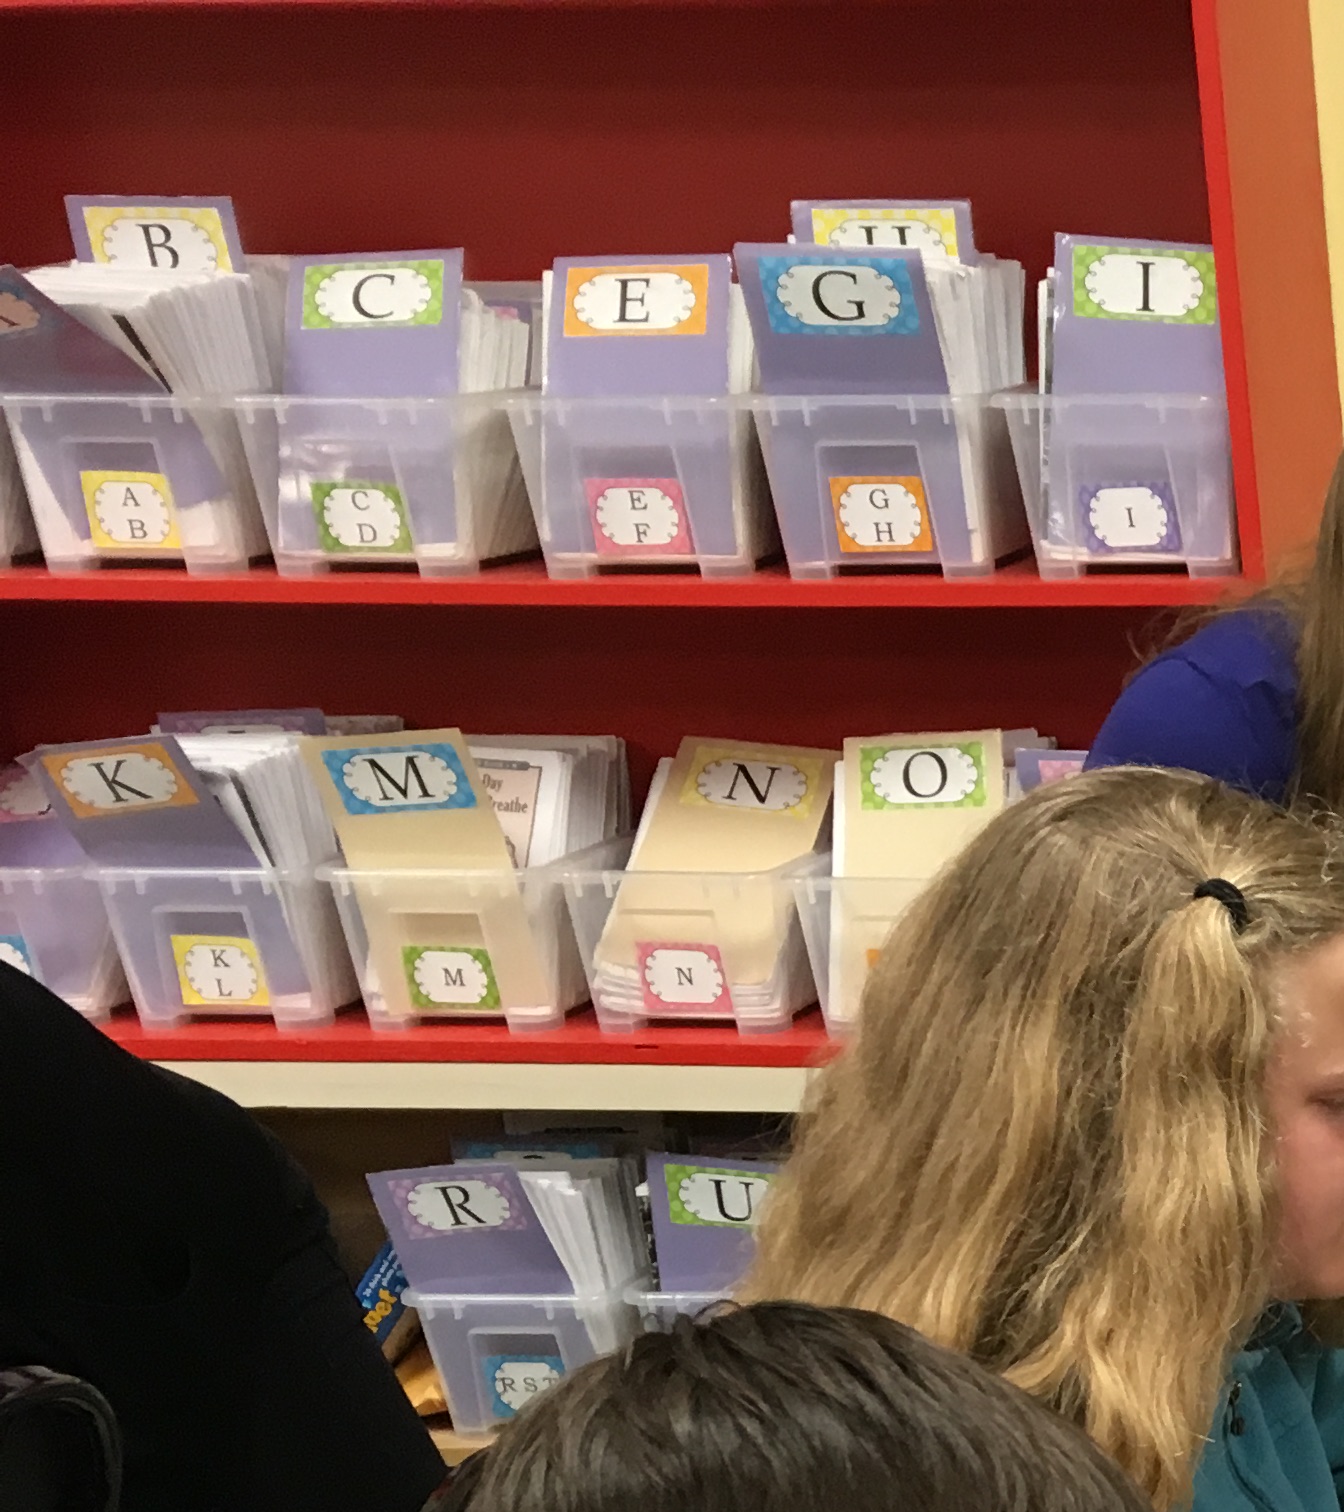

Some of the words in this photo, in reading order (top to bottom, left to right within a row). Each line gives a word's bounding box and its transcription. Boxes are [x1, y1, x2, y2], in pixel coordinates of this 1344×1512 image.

[136, 222, 180, 269] B
[352, 273, 396, 320] C
[811, 270, 867, 322] G
[1134, 261, 1157, 313] I
[613, 277, 651, 323] E
[121, 487, 140, 508] A
[351, 490, 370, 511] C
[629, 490, 648, 511] E
[868, 488, 891, 510] G
[127, 518, 148, 540] B
[357, 523, 378, 545] D
[634, 523, 652, 543] F
[874, 522, 896, 543] H
[90, 759, 153, 802] K
[363, 755, 436, 801] M
[726, 763, 781, 804] N
[902, 751, 949, 798] O
[488, 795, 529, 813] reathe
[212, 949, 231, 968] K
[443, 967, 466, 988] M
[676, 967, 694, 986] N
[217, 979, 234, 997] L
[435, 1185, 486, 1226] R
[709, 1180, 754, 1221] U
[496, 1376, 518, 1394] R
[522, 1376, 539, 1393] S
